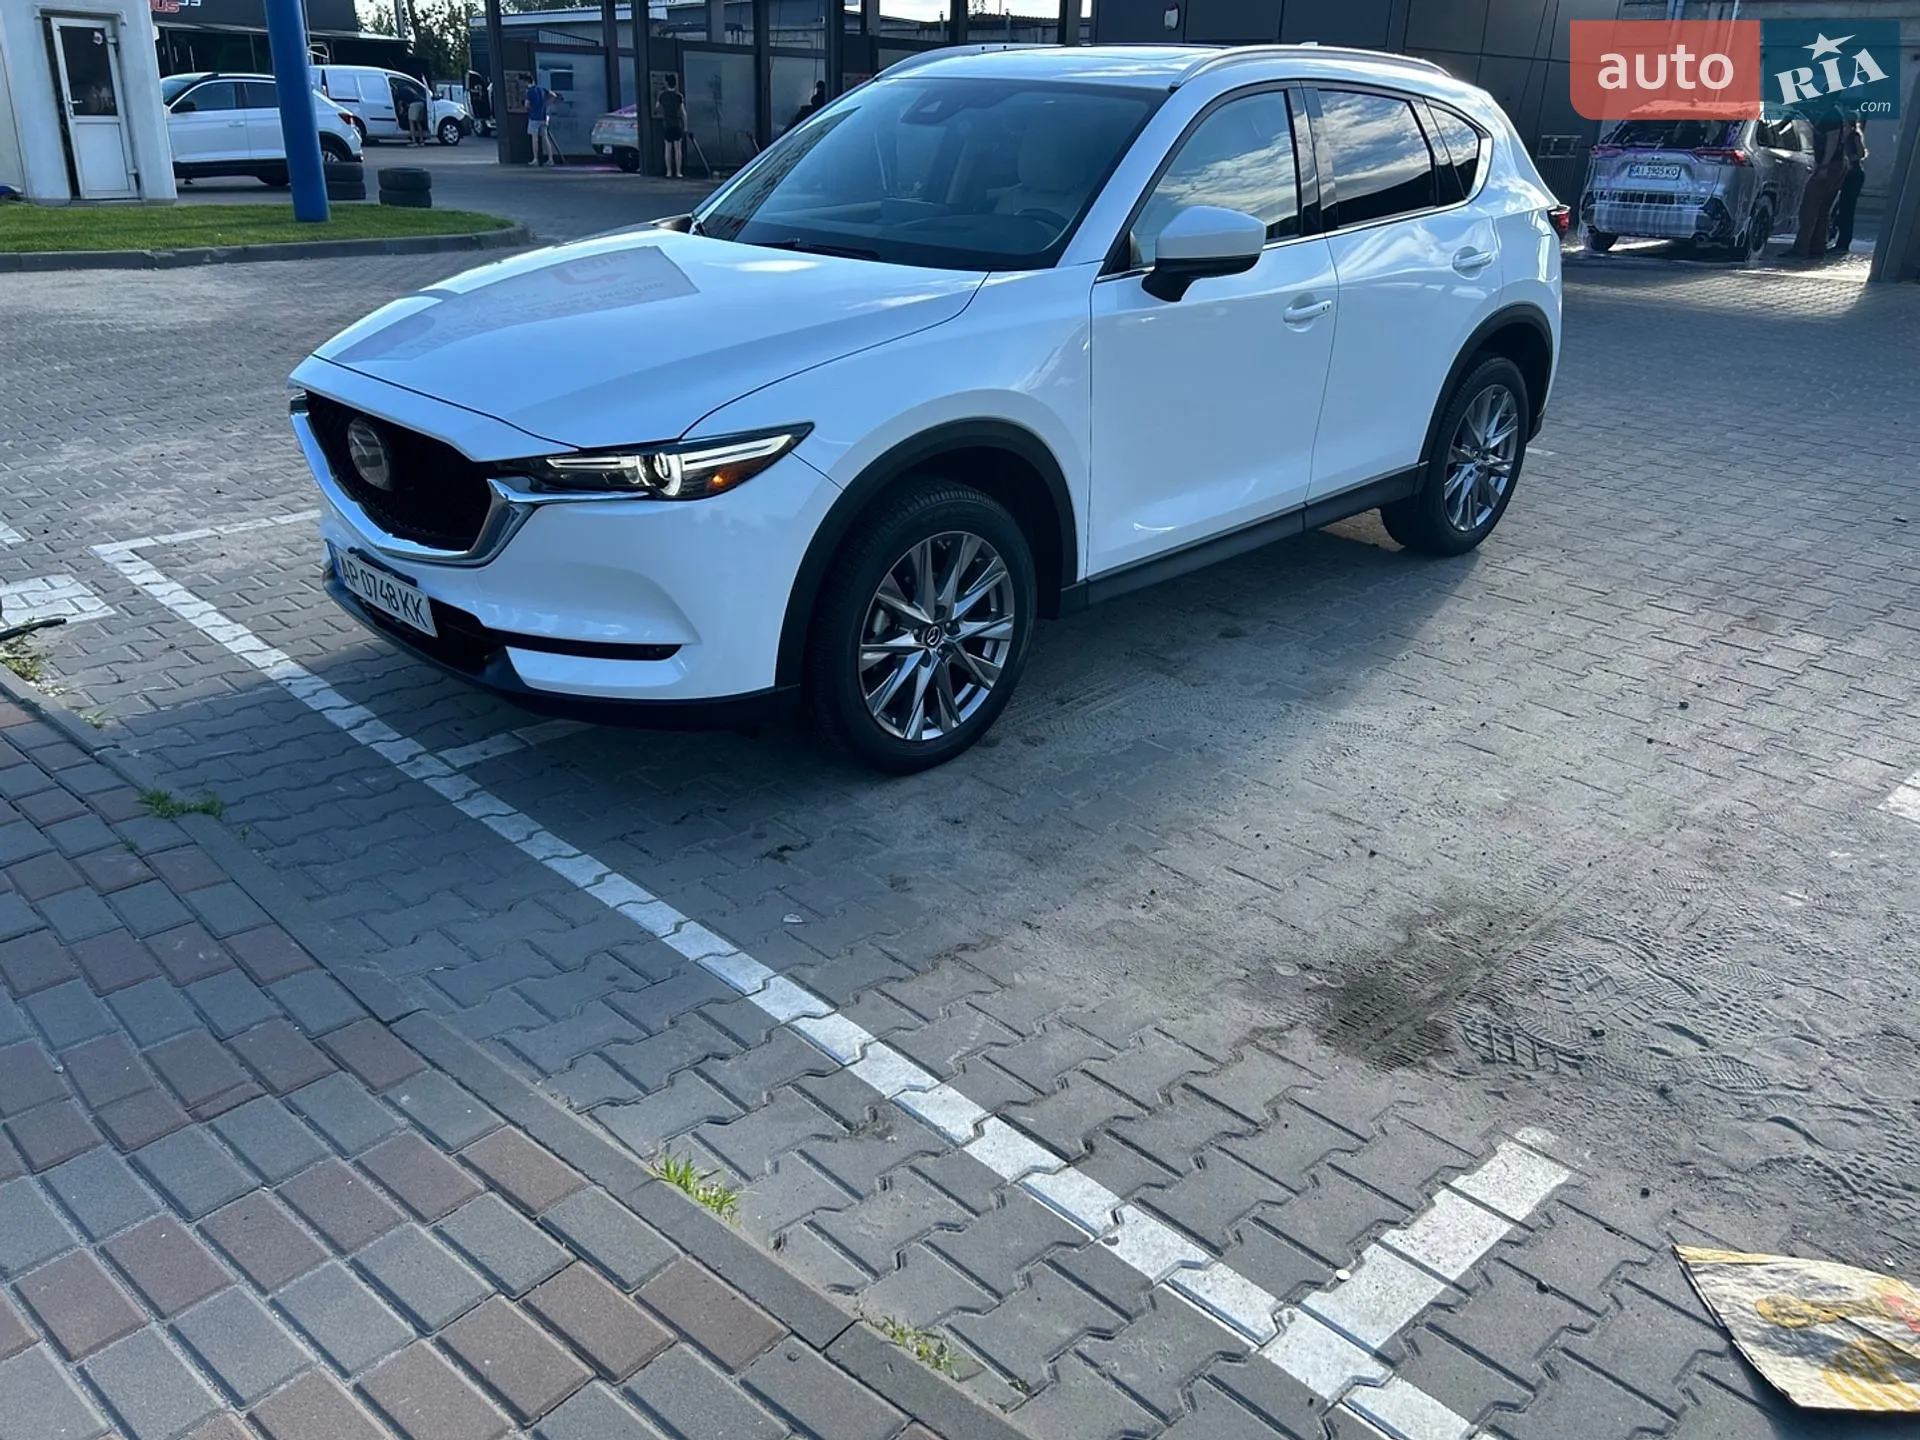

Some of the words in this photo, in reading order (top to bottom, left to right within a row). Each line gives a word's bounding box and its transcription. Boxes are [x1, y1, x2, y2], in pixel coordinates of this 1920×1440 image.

[340, 556, 359, 586] AP
[360, 568, 399, 611] 0748
[398, 587, 428, 628] KK
